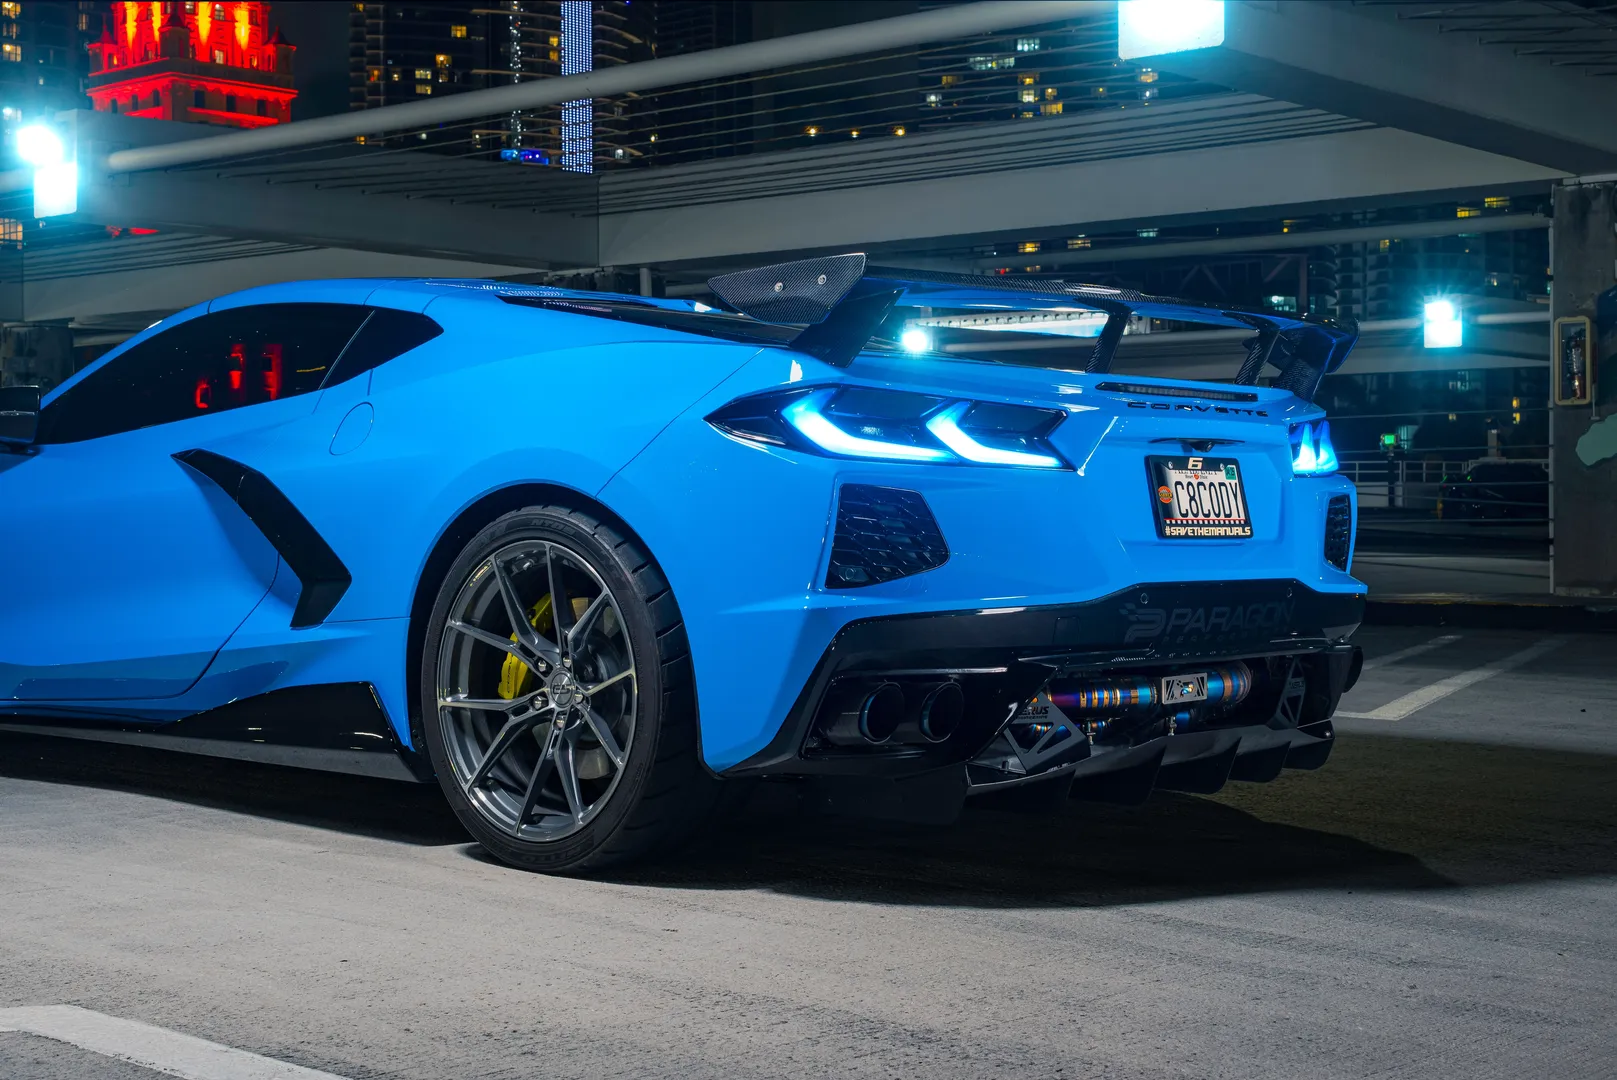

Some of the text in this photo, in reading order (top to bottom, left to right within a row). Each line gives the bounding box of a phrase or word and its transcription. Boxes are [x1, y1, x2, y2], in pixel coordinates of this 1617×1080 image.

[1128, 402, 1268, 417] CORVETTE
[1165, 526, 1251, 536] #SAVETHEMANUALS
[1166, 598, 1296, 636] PARAGON
